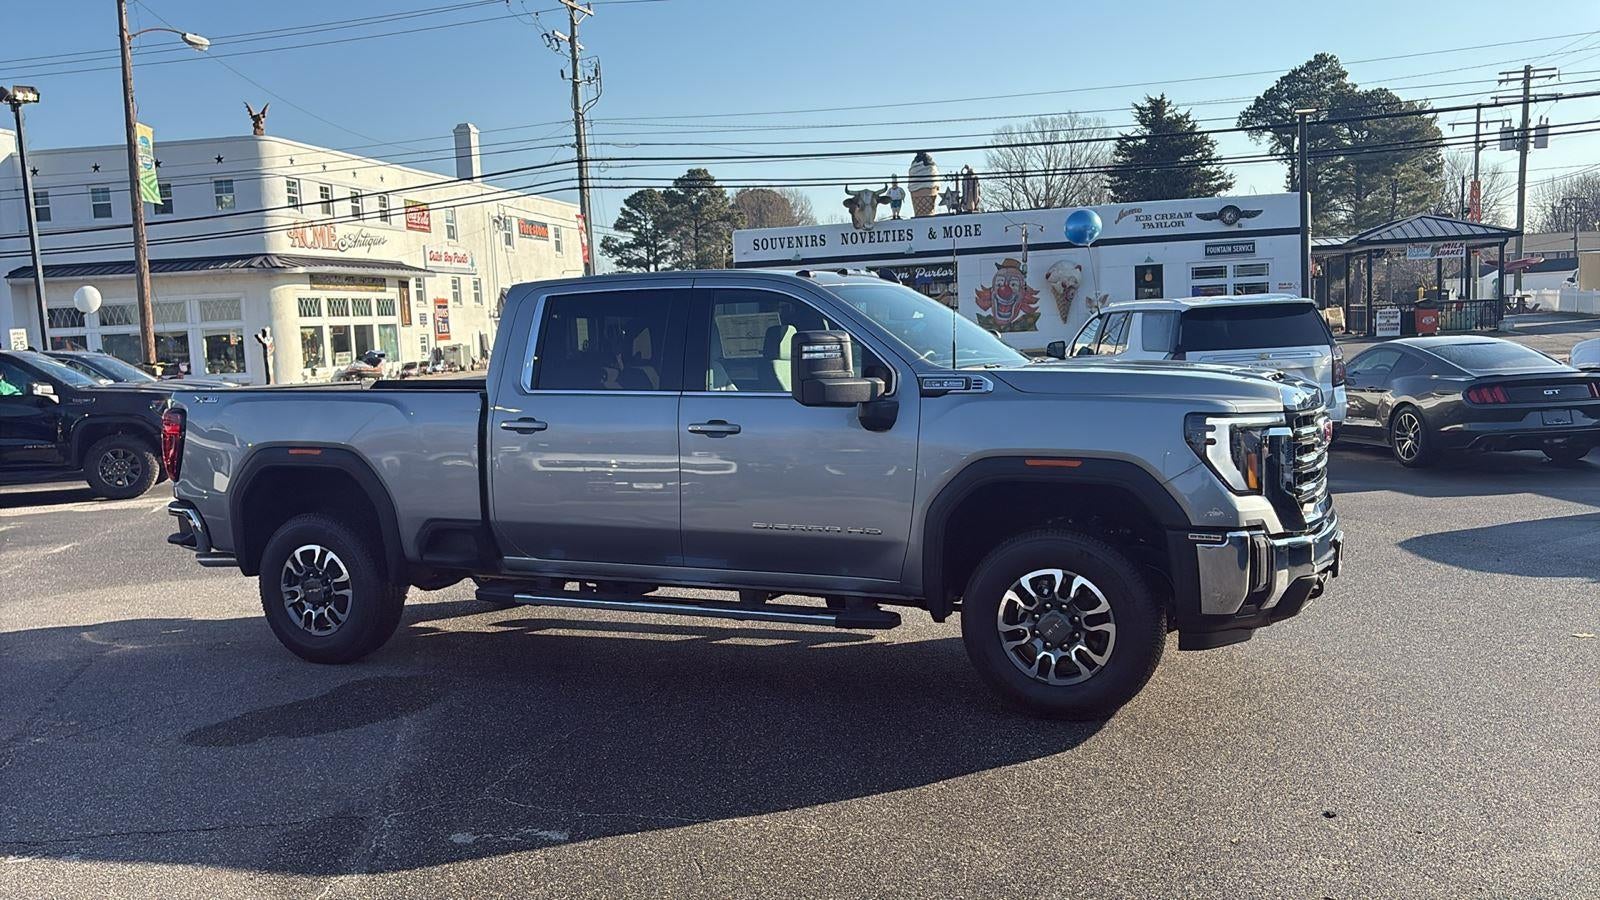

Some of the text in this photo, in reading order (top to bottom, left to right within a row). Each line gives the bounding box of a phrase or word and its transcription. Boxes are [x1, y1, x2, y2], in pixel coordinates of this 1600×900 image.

[1154, 211, 1193, 220] CREAM
[1142, 220, 1185, 229] PARLOR
[287, 222, 337, 250] ACME
[753, 224, 982, 251] SOUVENIRS NOVELTIES & MORE
[1206, 244, 1253, 254] FOUNTAIN SERVICE
[915, 267, 953, 279] Parlor
[13, 341, 26, 350] 25
[752, 522, 882, 535] SIERRA HD
